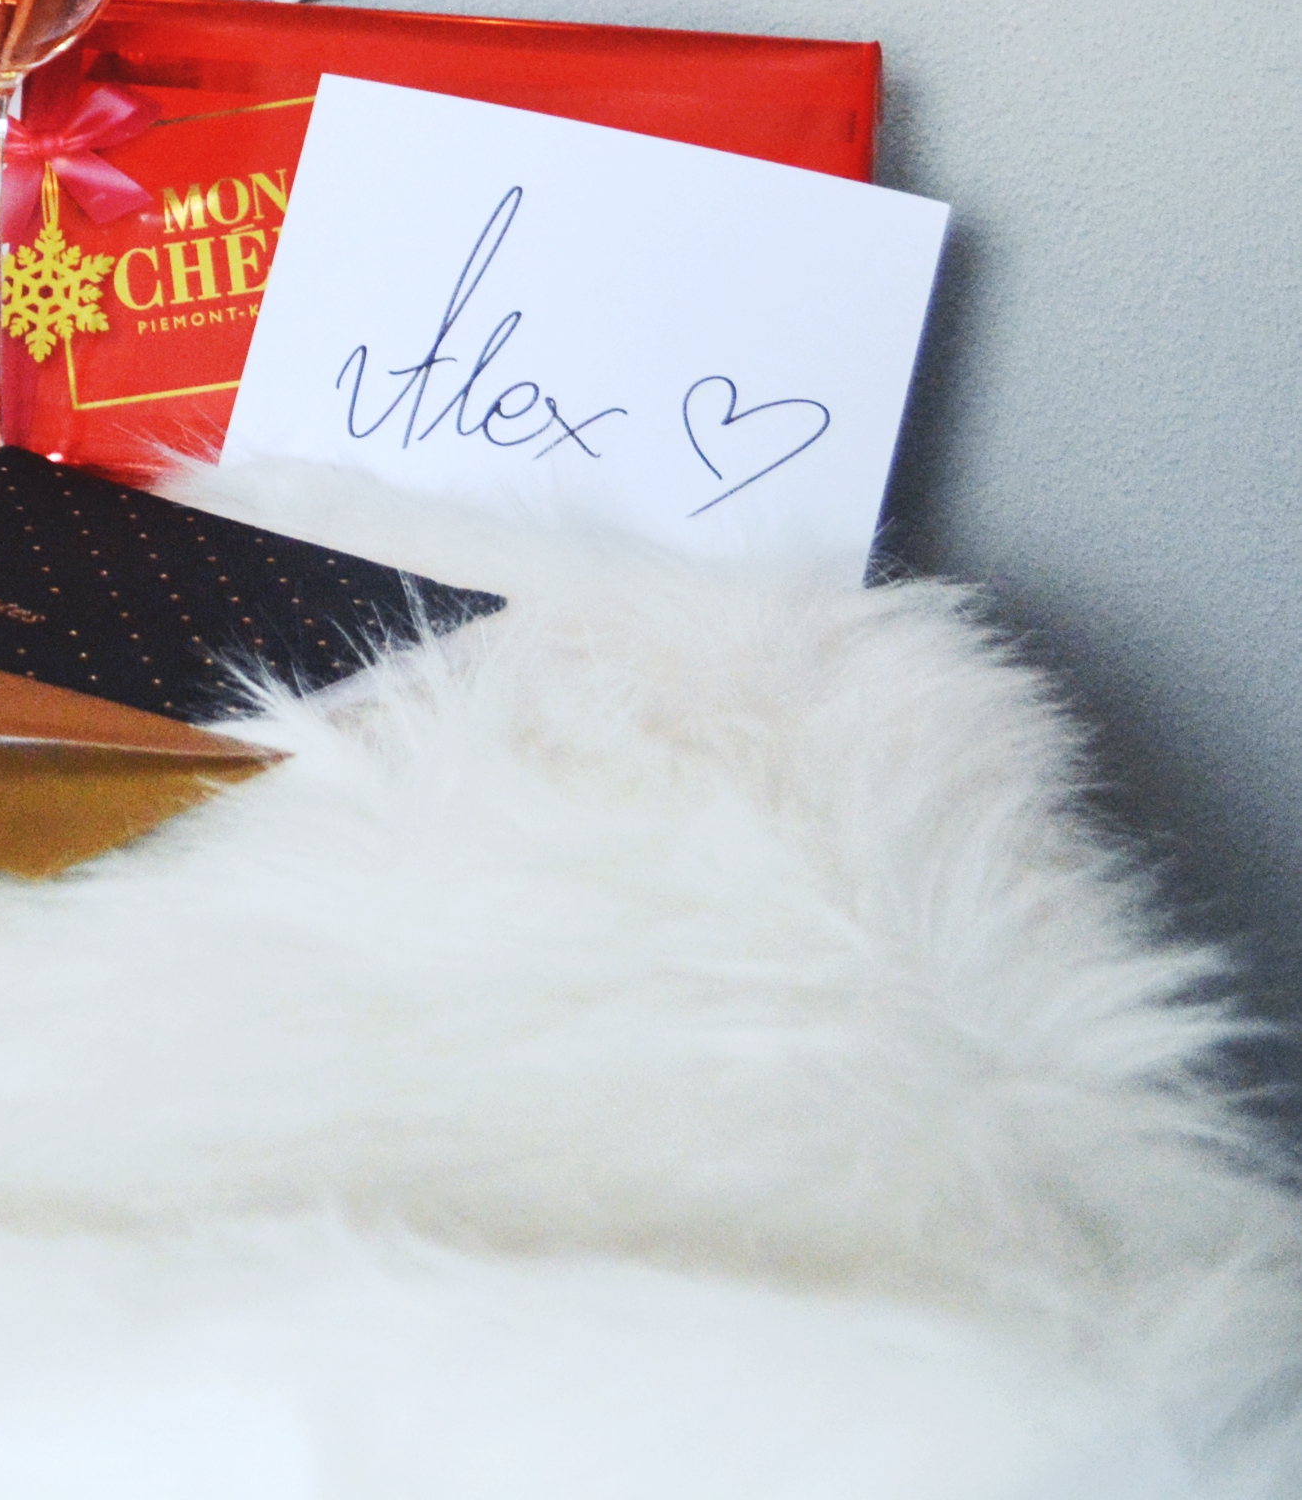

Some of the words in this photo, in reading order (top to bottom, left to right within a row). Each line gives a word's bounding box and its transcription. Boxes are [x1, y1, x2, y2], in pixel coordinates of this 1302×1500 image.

[161, 168, 288, 234] MON
[113, 223, 283, 312] CHÉ
[336, 185, 628, 460] Alex
